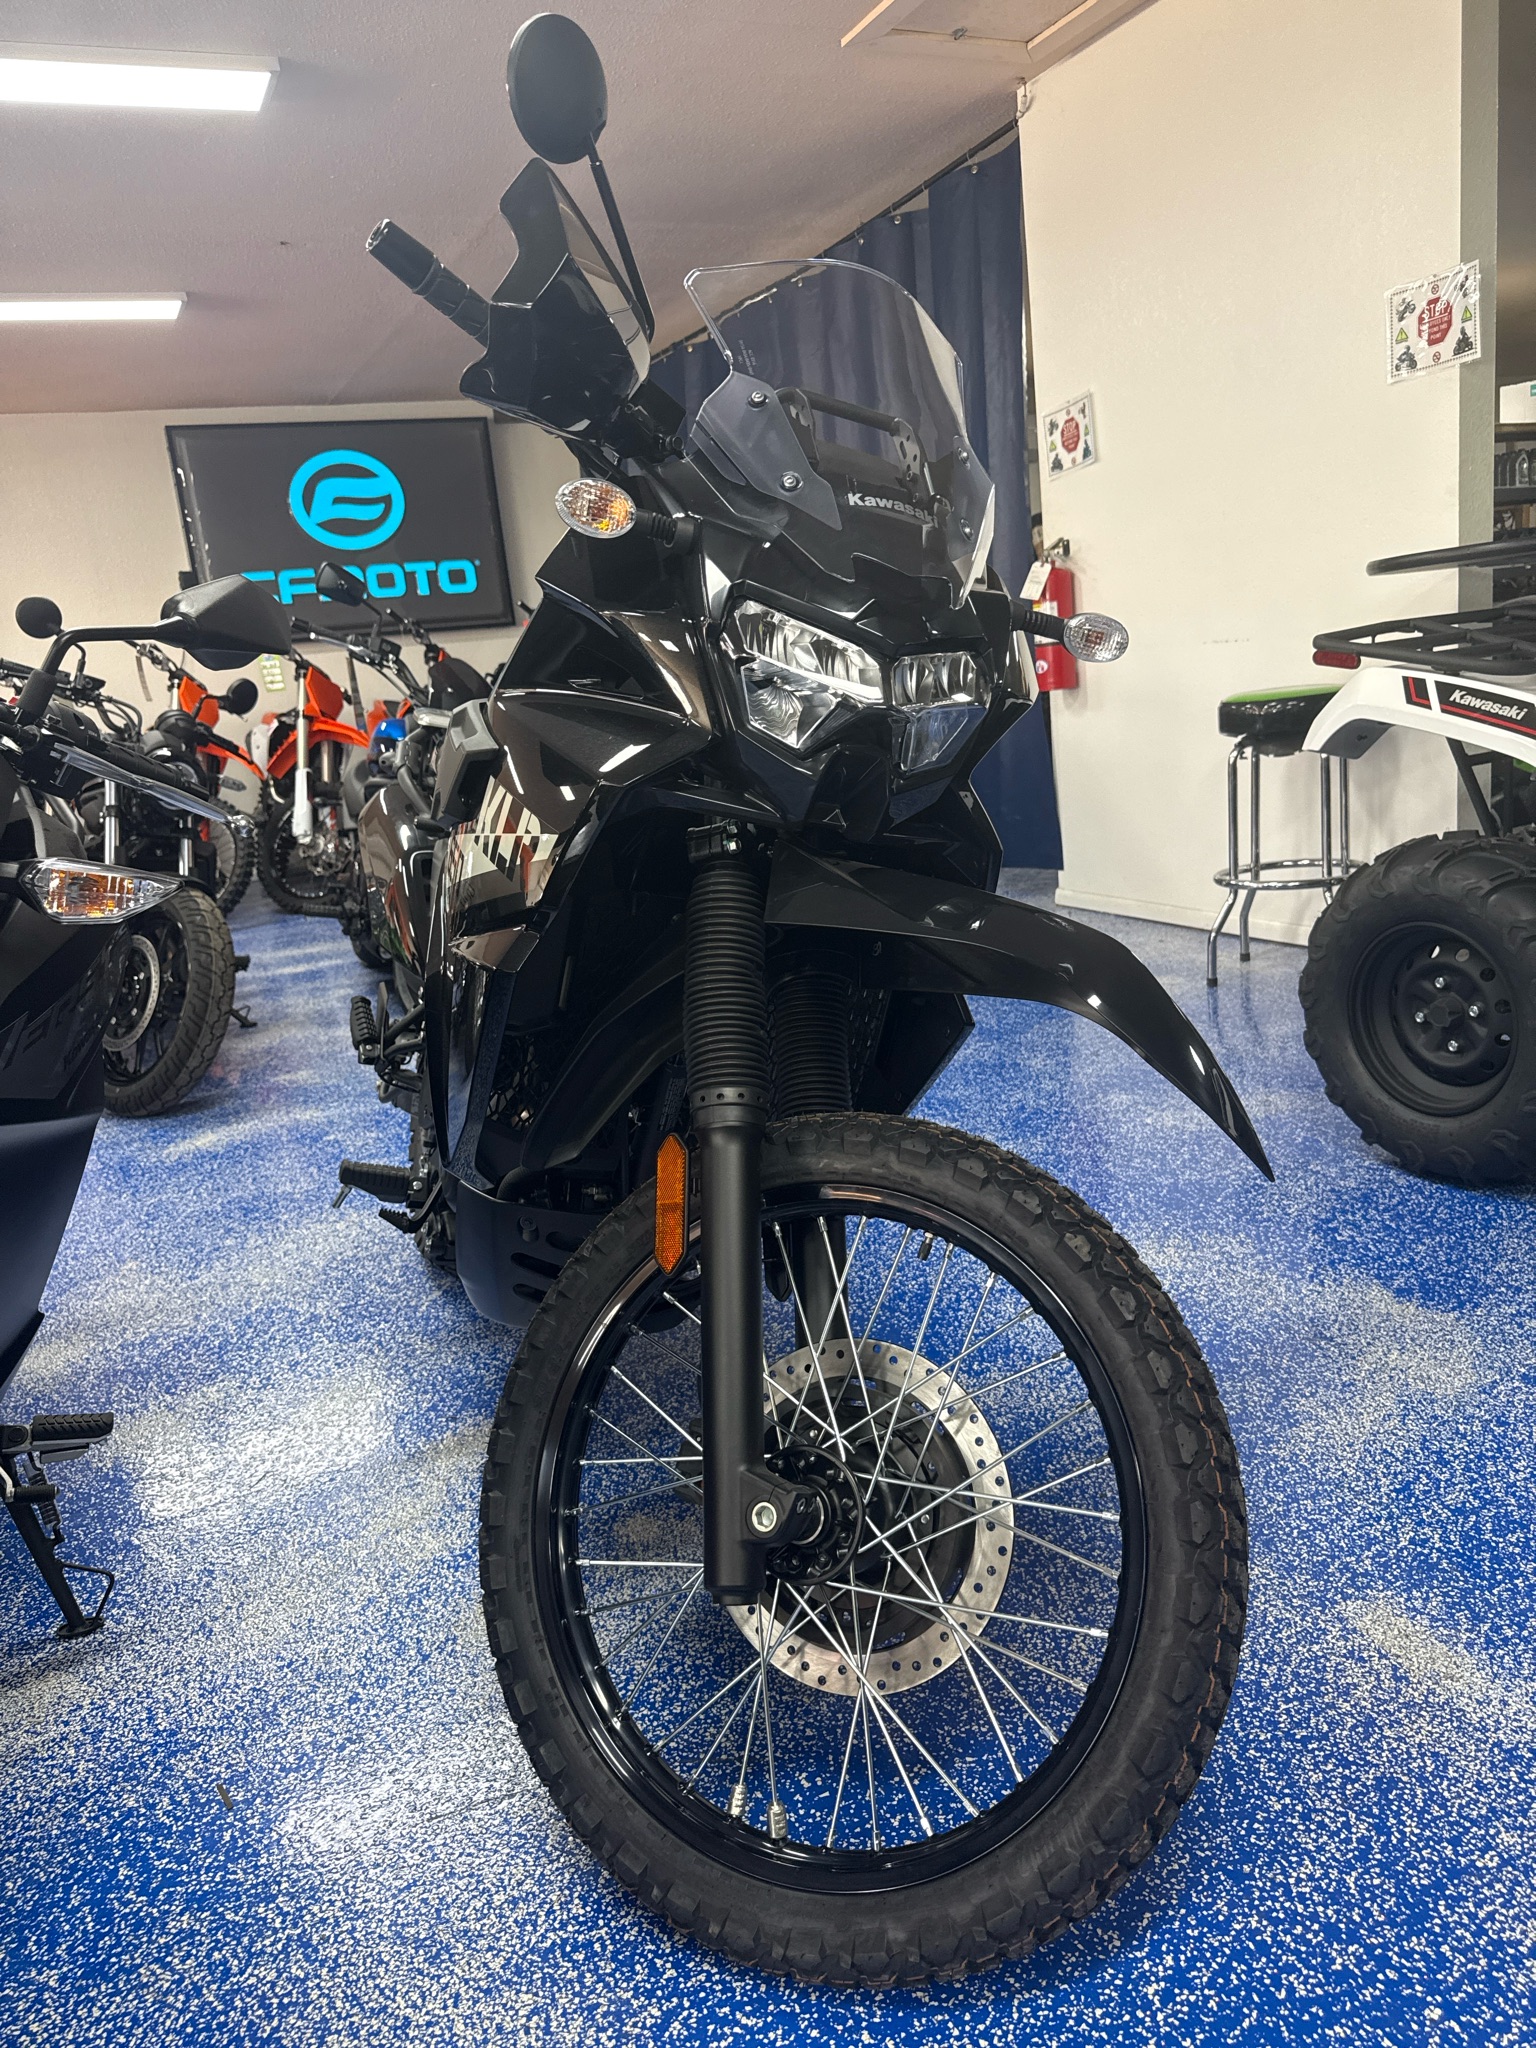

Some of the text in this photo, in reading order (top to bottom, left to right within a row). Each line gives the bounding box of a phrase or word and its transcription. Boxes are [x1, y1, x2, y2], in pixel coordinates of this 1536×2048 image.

[1063, 421, 1076, 434] STOP
[847, 493, 938, 528] Kawasaki
[1449, 689, 1528, 721] Kawasaki
